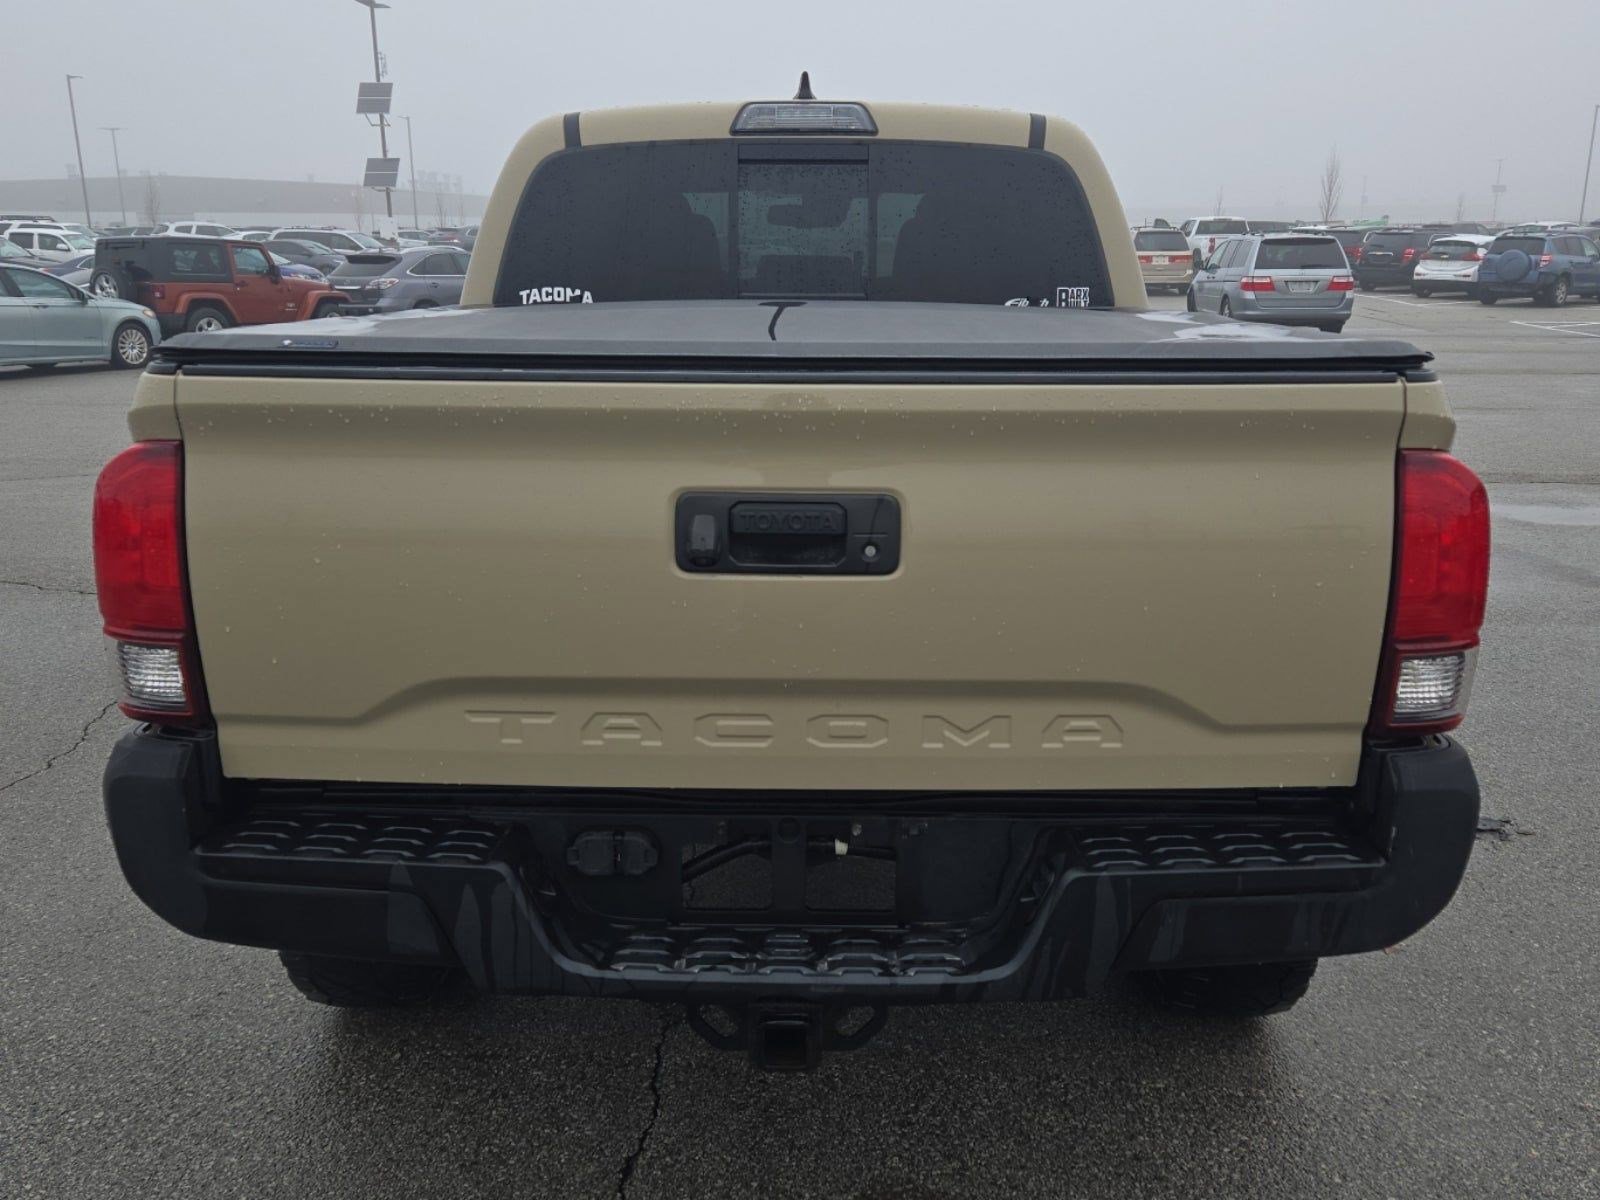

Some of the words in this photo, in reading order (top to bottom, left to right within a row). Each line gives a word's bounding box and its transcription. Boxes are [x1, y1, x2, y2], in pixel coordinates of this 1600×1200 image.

[519, 286, 594, 305] TACOMA
[740, 511, 837, 531] TOYOTA
[464, 710, 1124, 749] TACOMA
